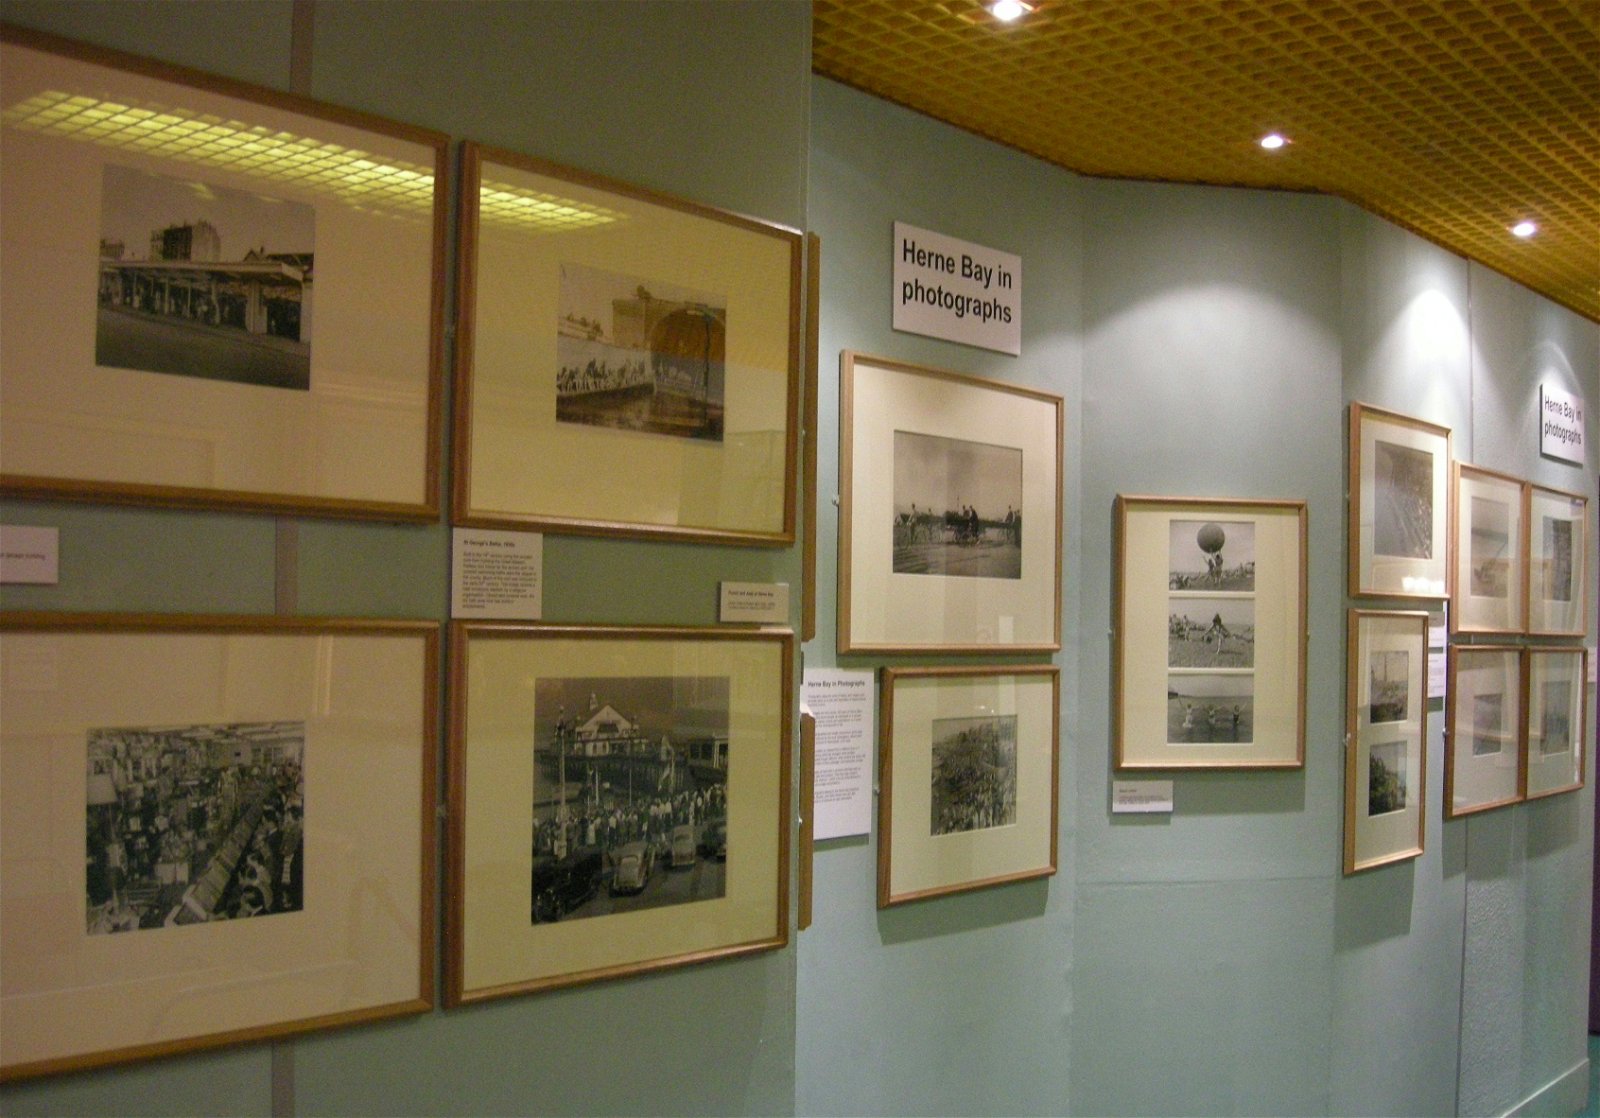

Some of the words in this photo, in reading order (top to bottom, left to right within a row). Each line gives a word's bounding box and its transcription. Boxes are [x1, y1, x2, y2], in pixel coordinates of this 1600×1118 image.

[903, 238, 955, 274] Herne
[961, 254, 992, 289] Bay
[998, 264, 1012, 289] in
[902, 278, 1012, 323] photographs
[1544, 395, 1562, 415] Herne
[1564, 401, 1575, 423] Bay
[1575, 406, 1581, 422] in
[1544, 419, 1581, 446] photographs
[822, 680, 831, 688] Bay
[837, 680, 865, 688] Photographs
